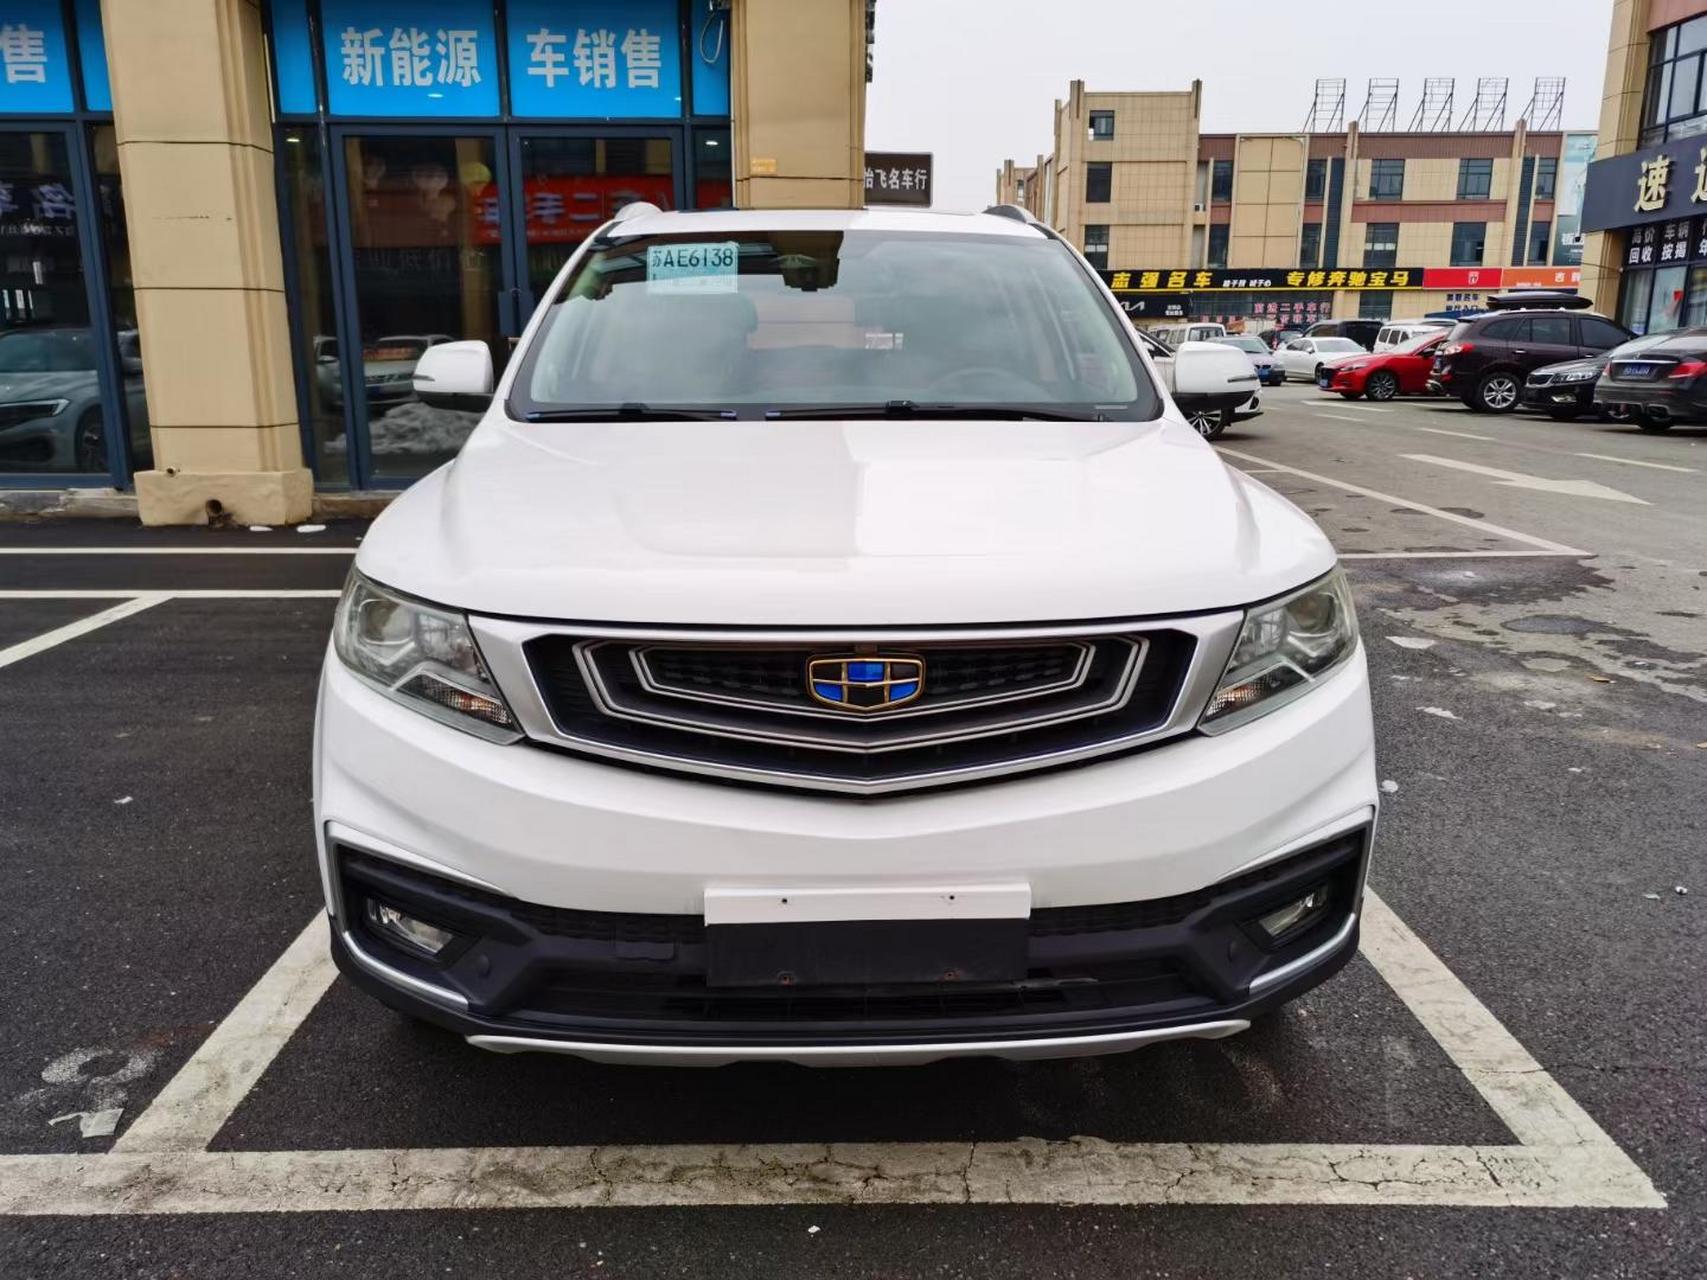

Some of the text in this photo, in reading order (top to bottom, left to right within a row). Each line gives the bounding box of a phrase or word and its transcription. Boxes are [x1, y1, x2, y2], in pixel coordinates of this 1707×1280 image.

[0, 25, 48, 84] 售
[340, 27, 662, 89] 新能源 车销售
[652, 246, 734, 268] 苏AE6138
[1628, 245, 1653, 265] 回收
[1111, 271, 1213, 288] 志强名车
[1286, 270, 1409, 287] 专修奔驰宝马
